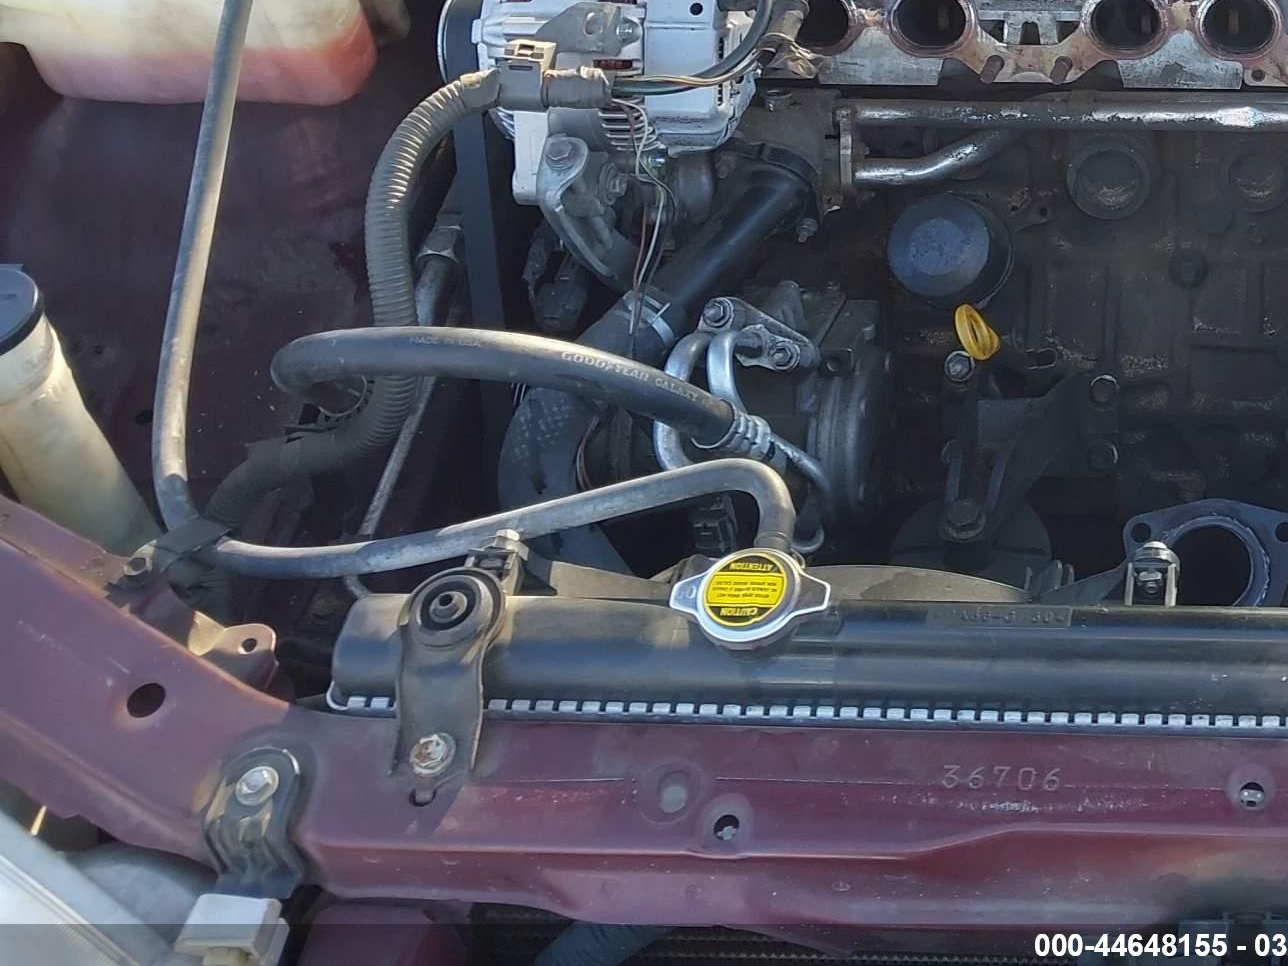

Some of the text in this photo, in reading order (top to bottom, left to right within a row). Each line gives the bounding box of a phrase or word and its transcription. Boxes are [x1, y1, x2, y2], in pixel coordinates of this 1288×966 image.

[561, 350, 649, 382] GOODYEAR
[729, 562, 773, 571] ATTENTION
[720, 607, 758, 616] CAUTION
[942, 765, 1061, 791] 36706
